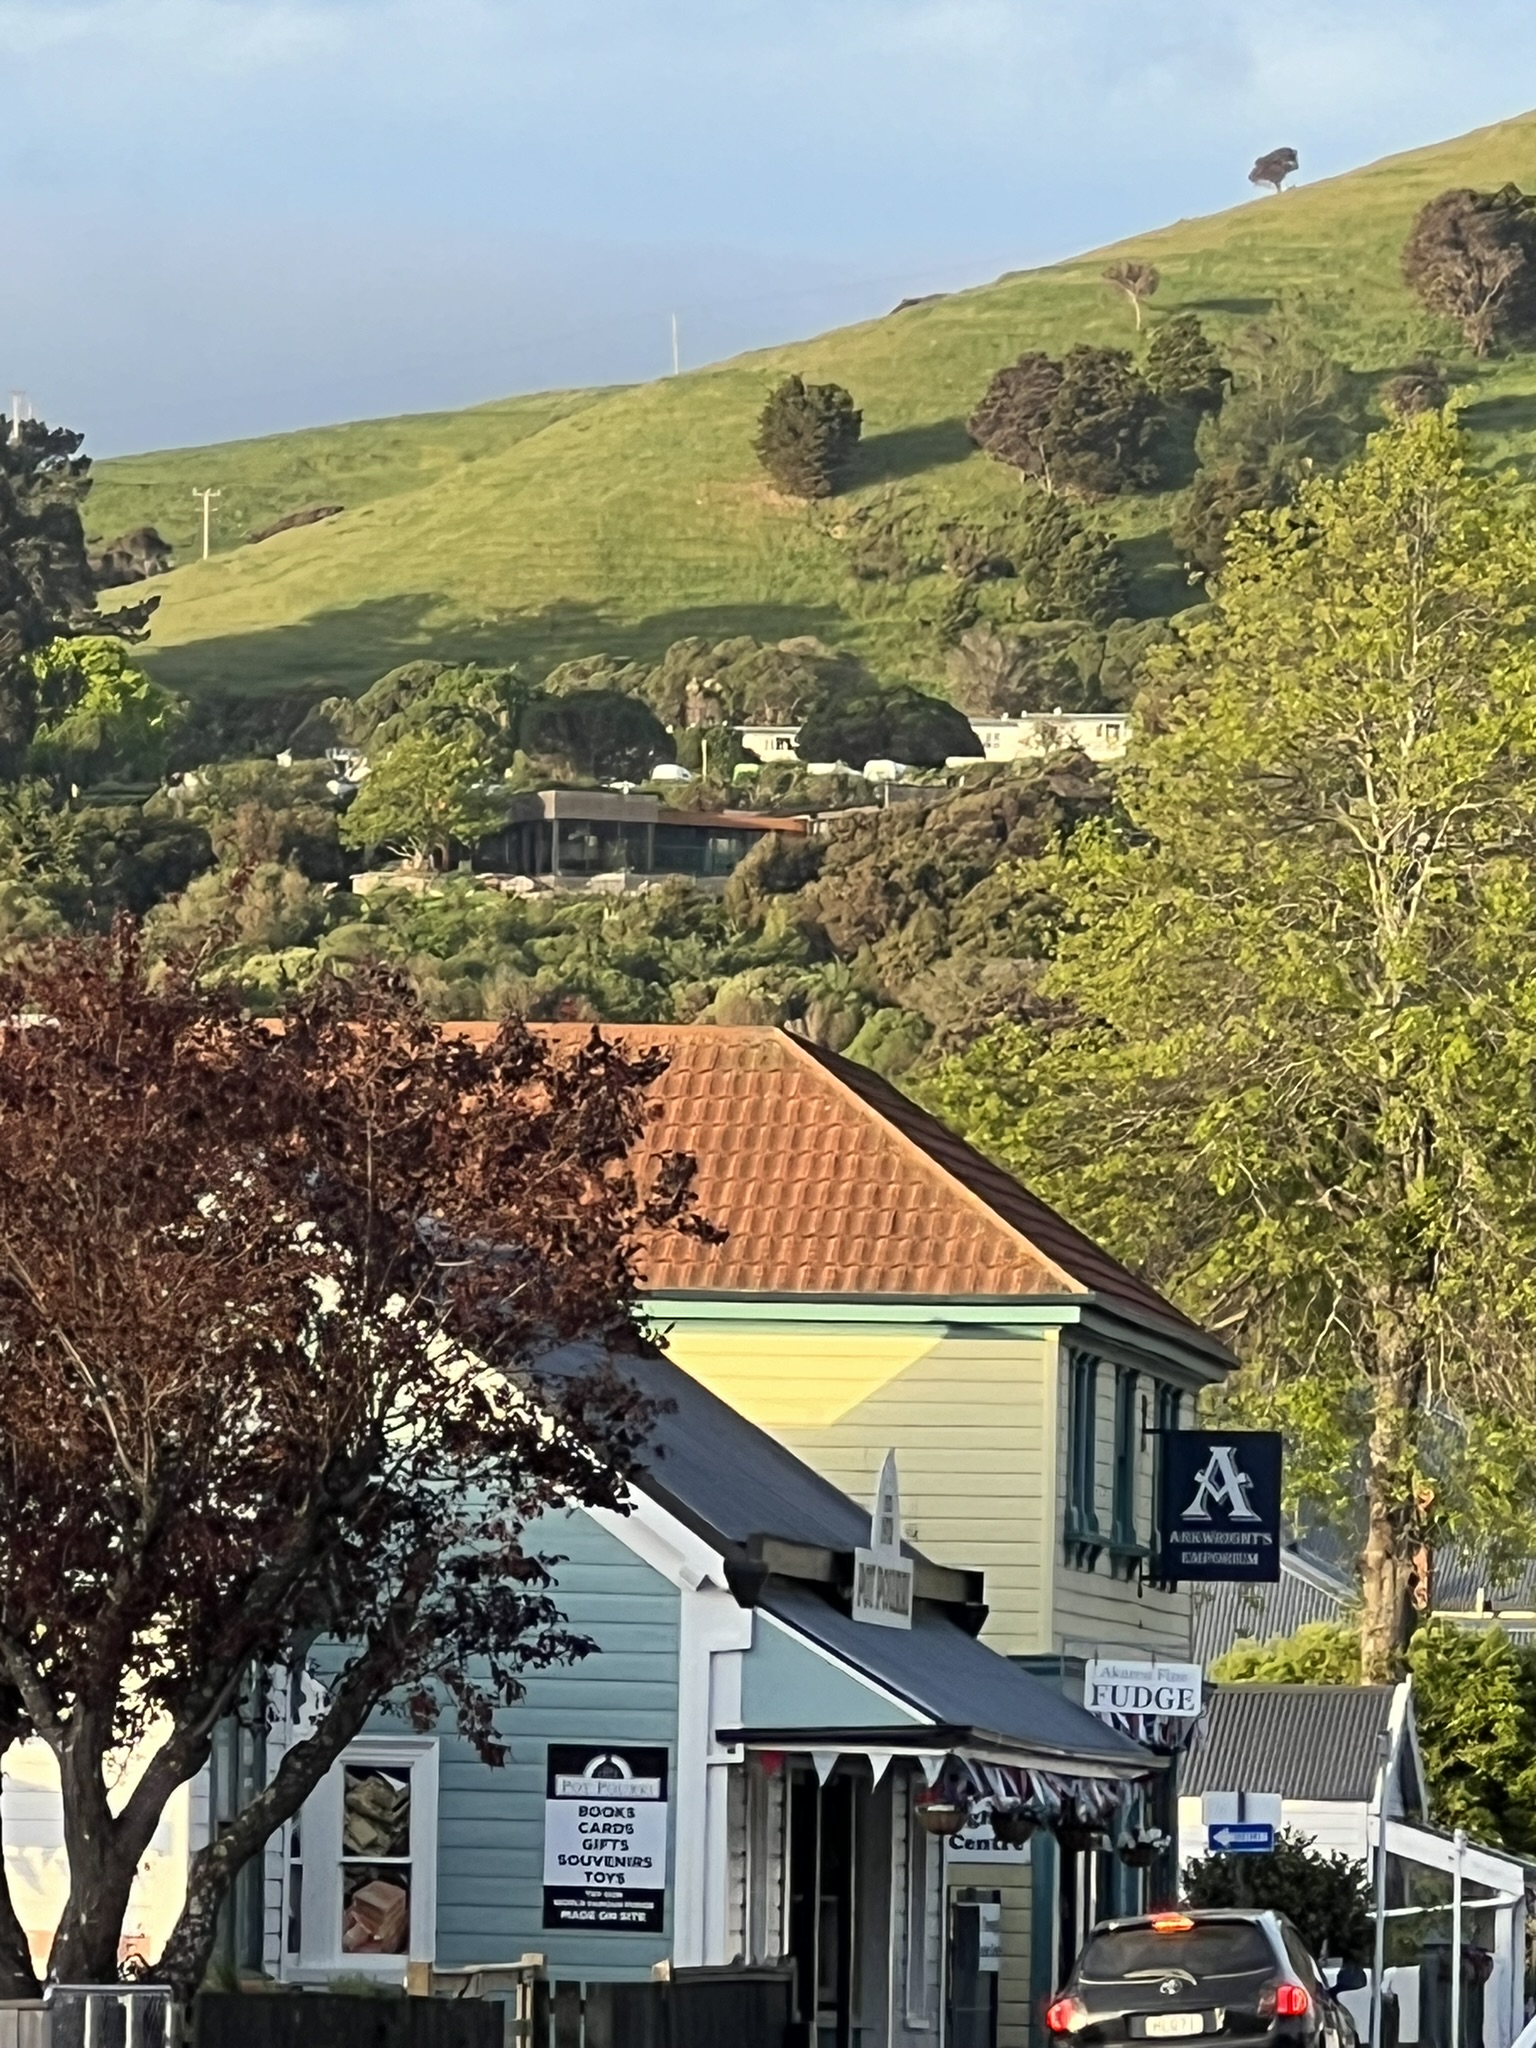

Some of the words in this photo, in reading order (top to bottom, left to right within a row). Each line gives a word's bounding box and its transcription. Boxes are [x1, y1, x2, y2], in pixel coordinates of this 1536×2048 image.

[1091, 1683, 1195, 1711] FUDGE
[578, 1805, 635, 1818] BOOKS
[578, 1822, 634, 1834] CARDS
[582, 1838, 629, 1851] GIFTS
[558, 1854, 653, 1868] SOUVENIRS
[584, 1871, 625, 1884] TOYS
